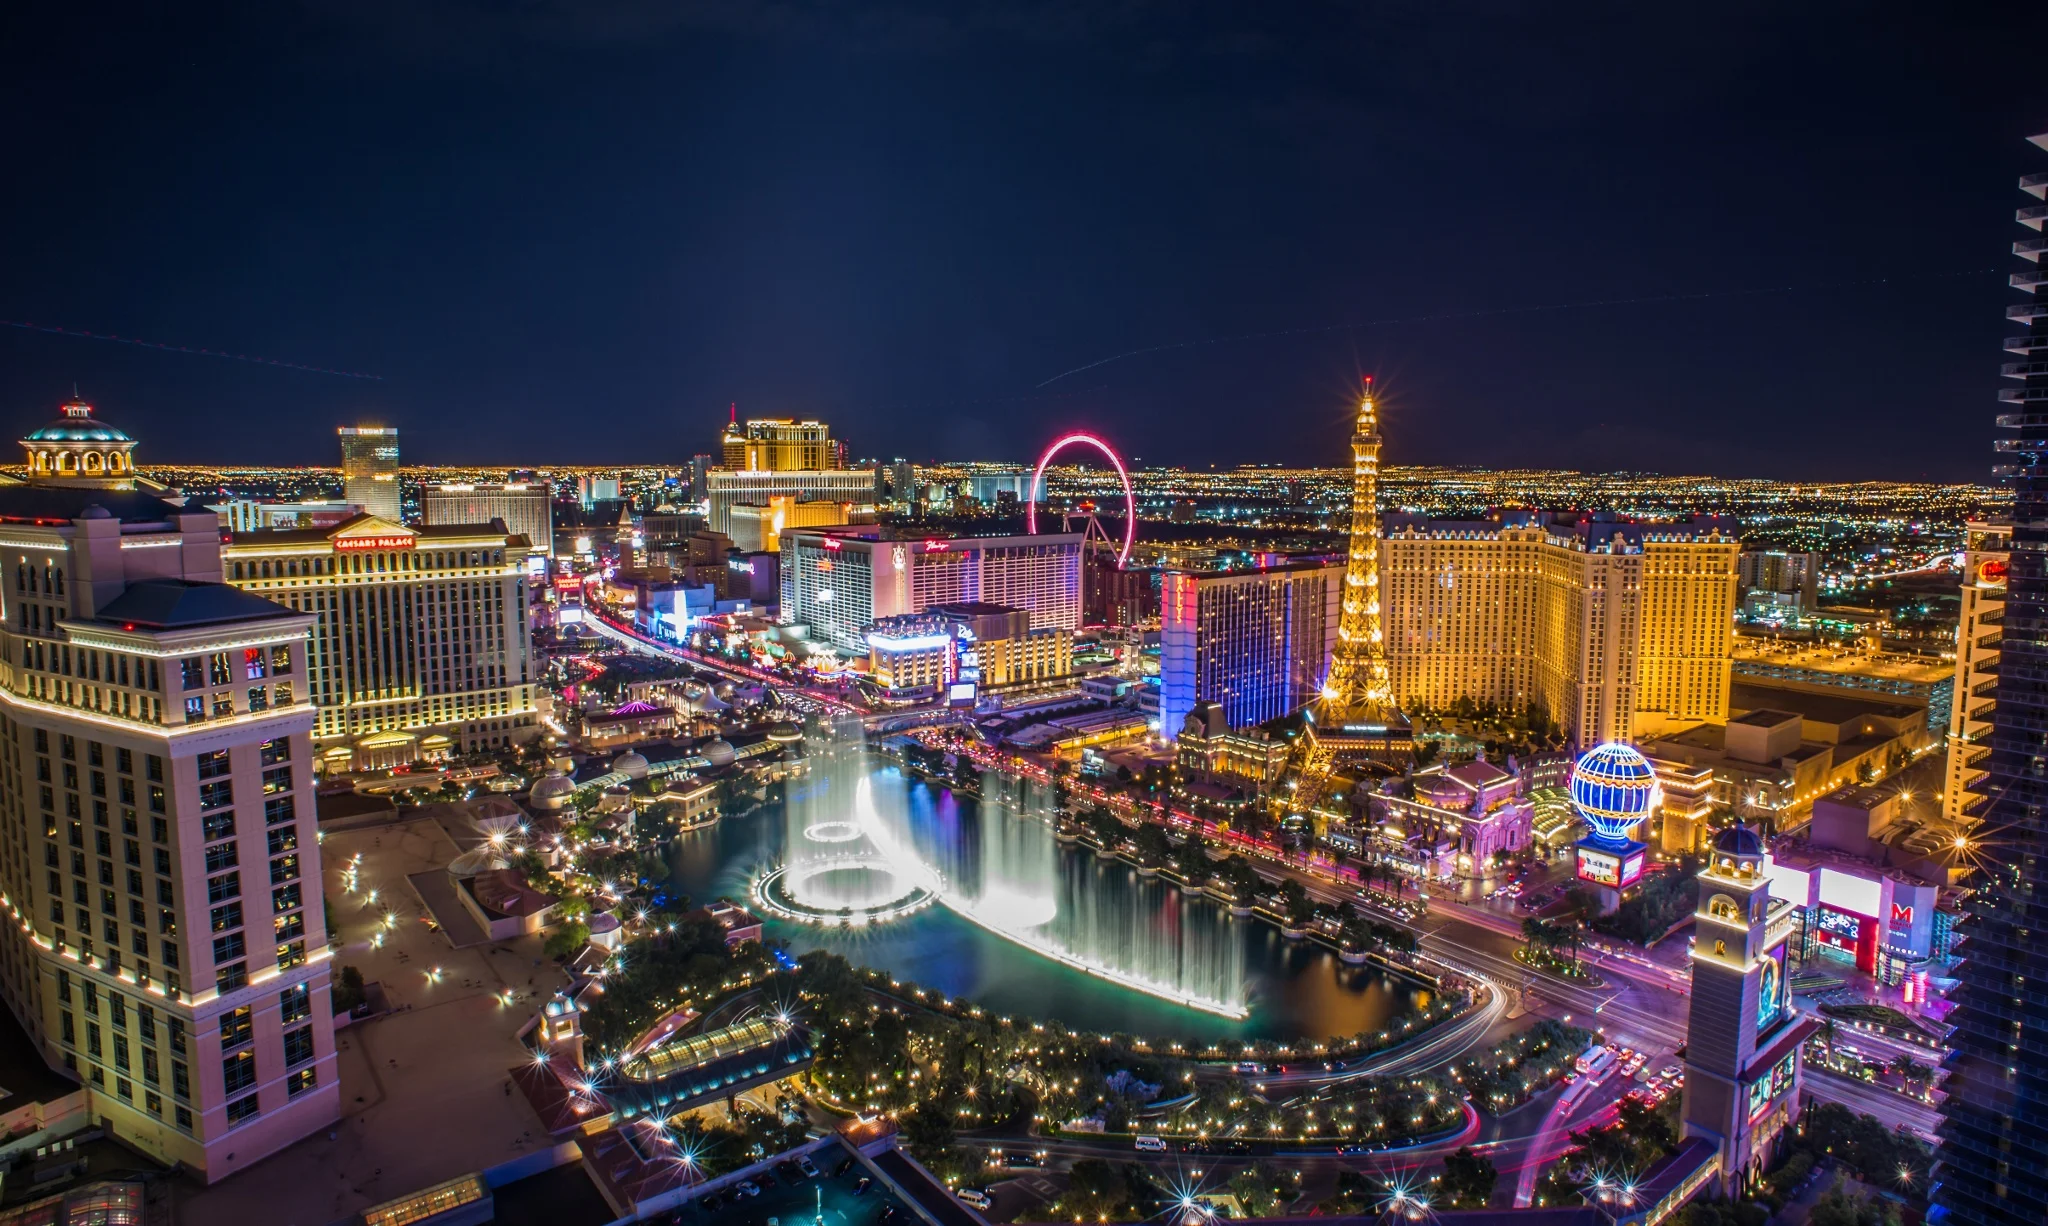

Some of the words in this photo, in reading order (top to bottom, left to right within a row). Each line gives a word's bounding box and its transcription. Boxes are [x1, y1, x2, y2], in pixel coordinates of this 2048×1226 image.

[336, 540, 376, 549] CAESARS
[378, 537, 412, 547] PALACE
[925, 540, 949, 551] Flamingo
[1892, 902, 1914, 924] M
[1881, 942, 1918, 956] SEPHORA
